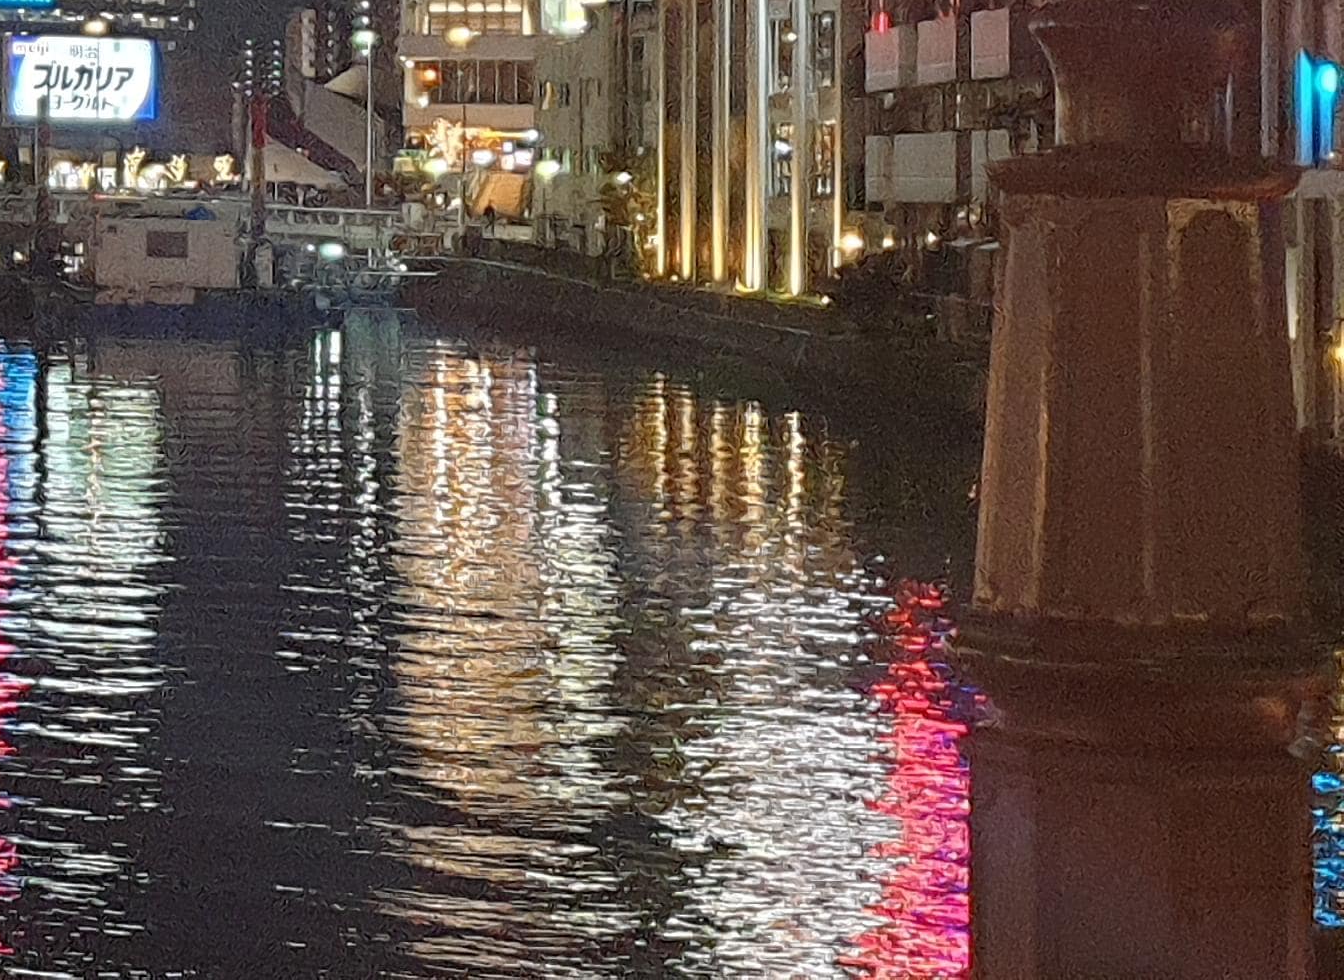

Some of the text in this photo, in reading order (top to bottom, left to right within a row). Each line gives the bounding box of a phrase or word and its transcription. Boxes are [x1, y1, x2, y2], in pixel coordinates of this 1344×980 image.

[33, 60, 135, 92] ブルガリア
